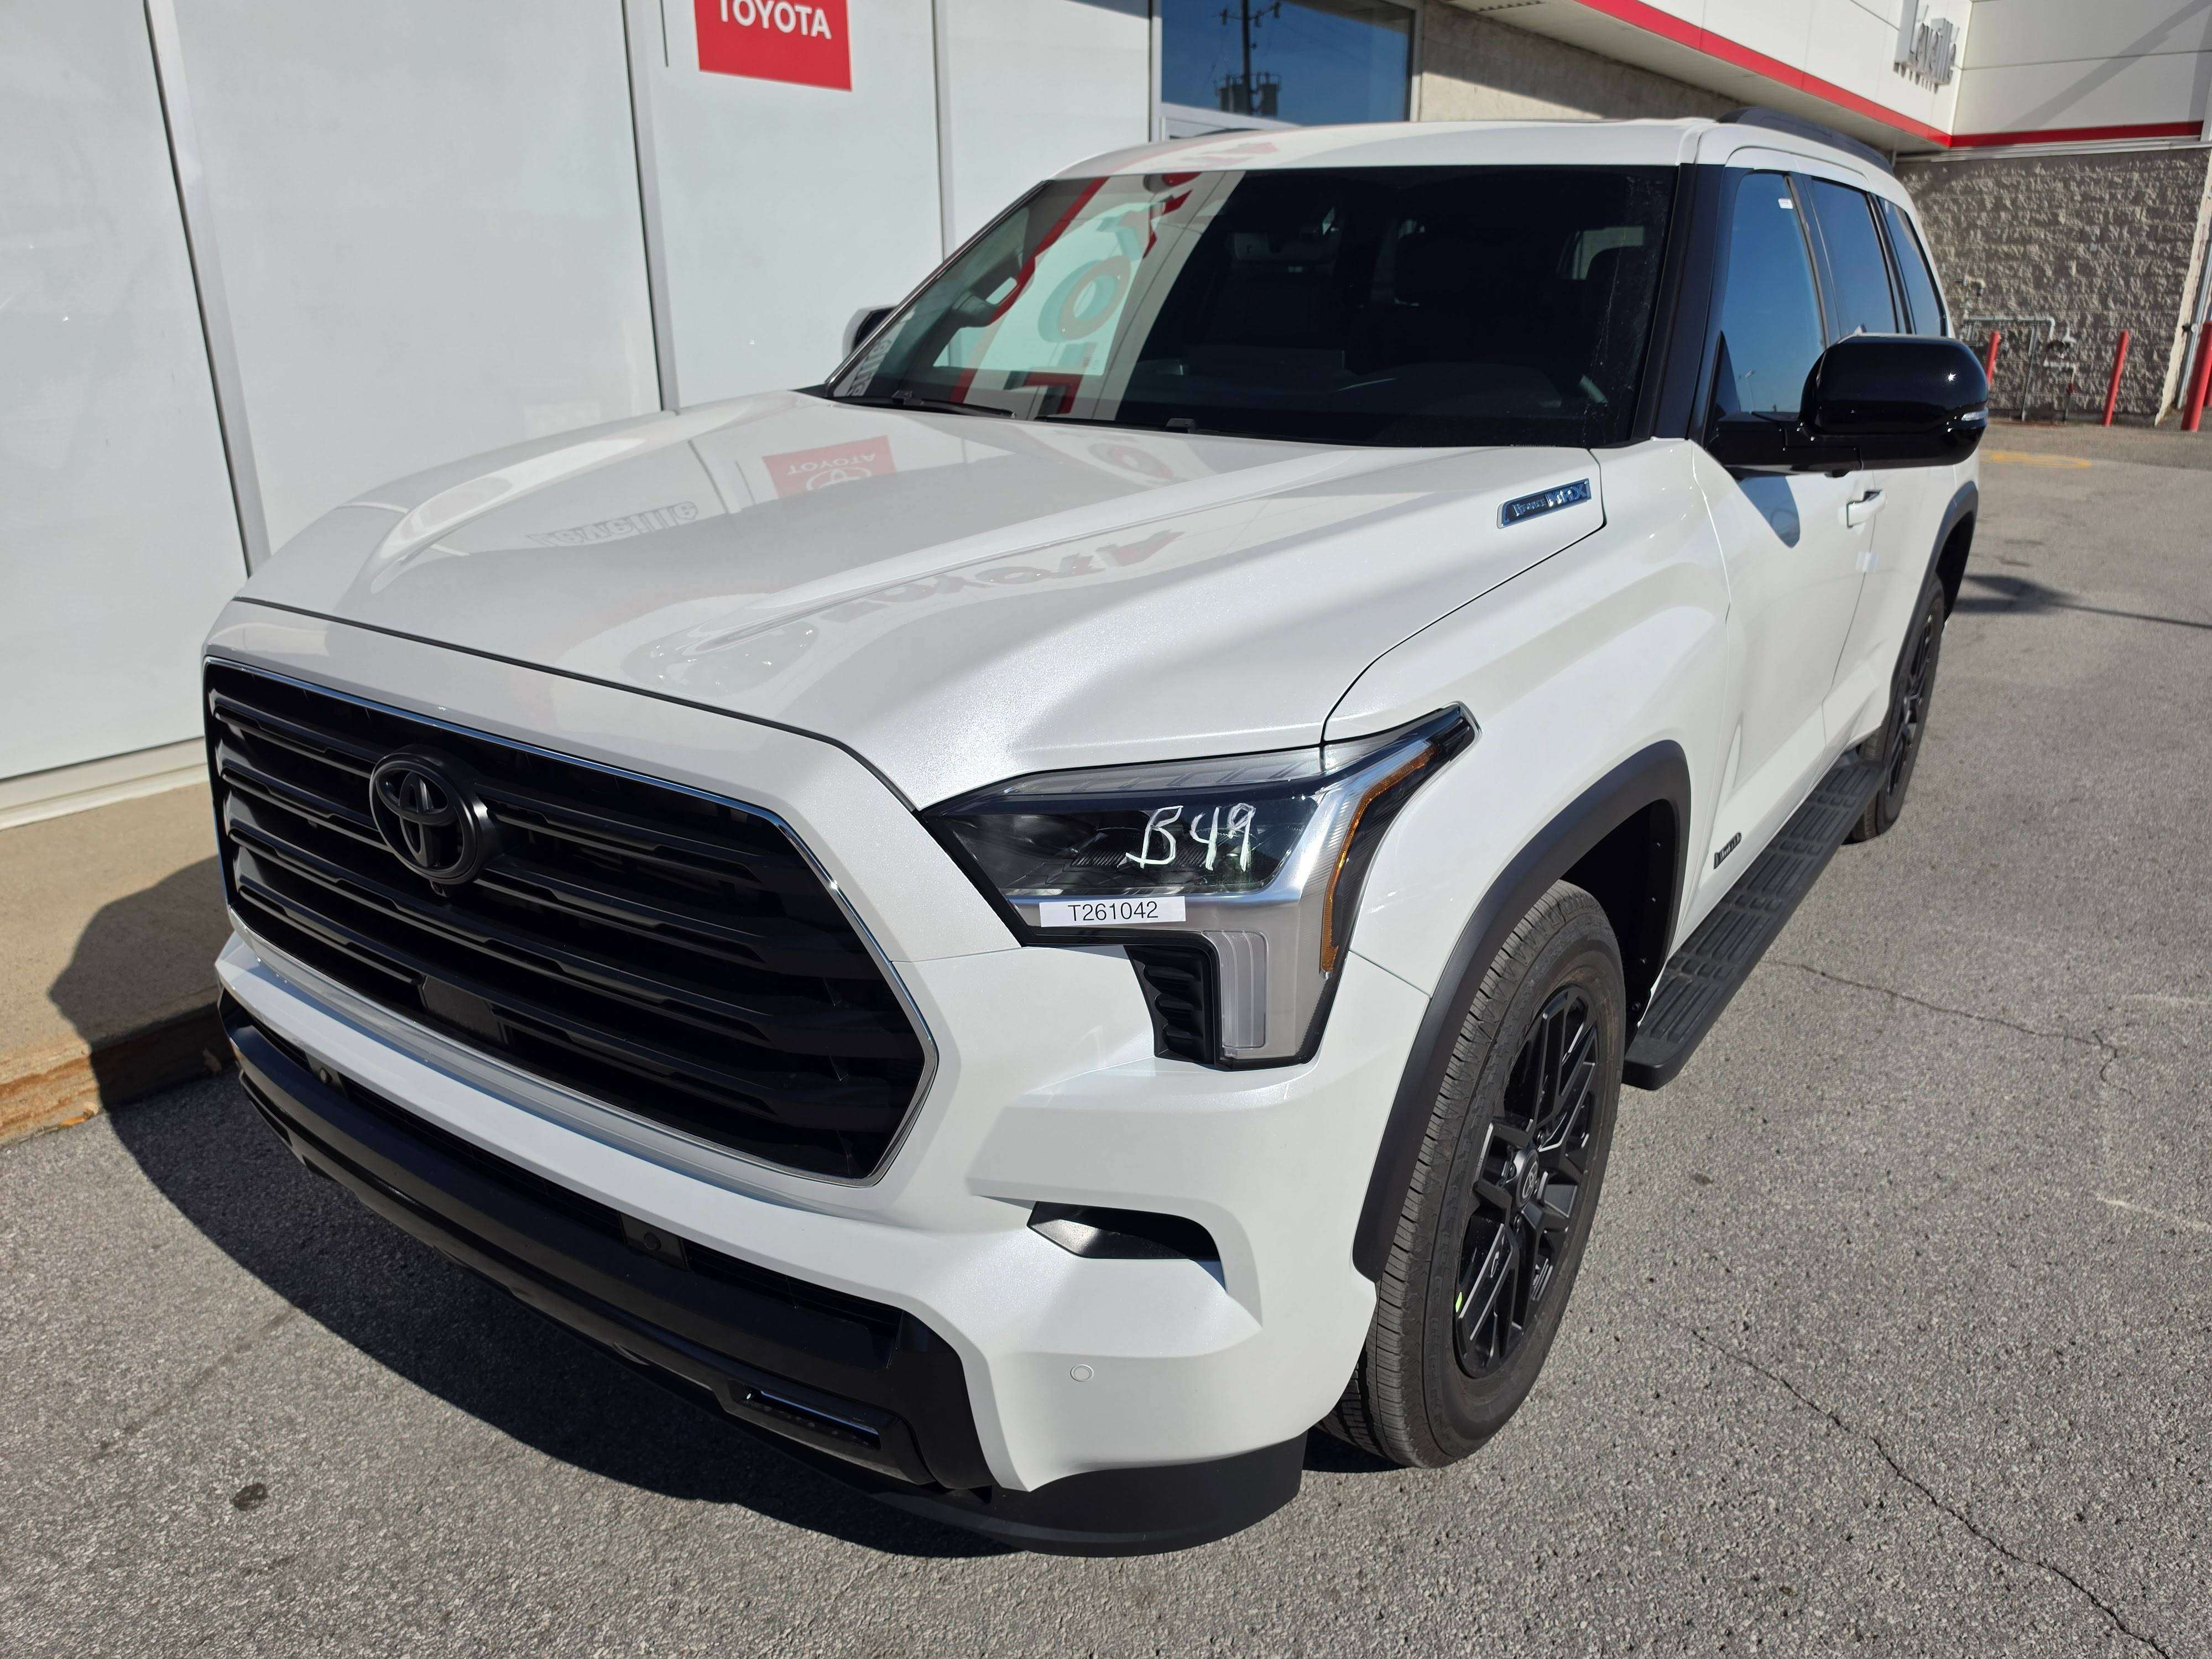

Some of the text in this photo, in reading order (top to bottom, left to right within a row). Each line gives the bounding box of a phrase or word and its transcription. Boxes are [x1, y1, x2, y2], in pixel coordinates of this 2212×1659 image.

[720, 0, 832, 40] TOYOTA
[1126, 802, 1256, 872] B49
[1067, 901, 1159, 922] T261042
